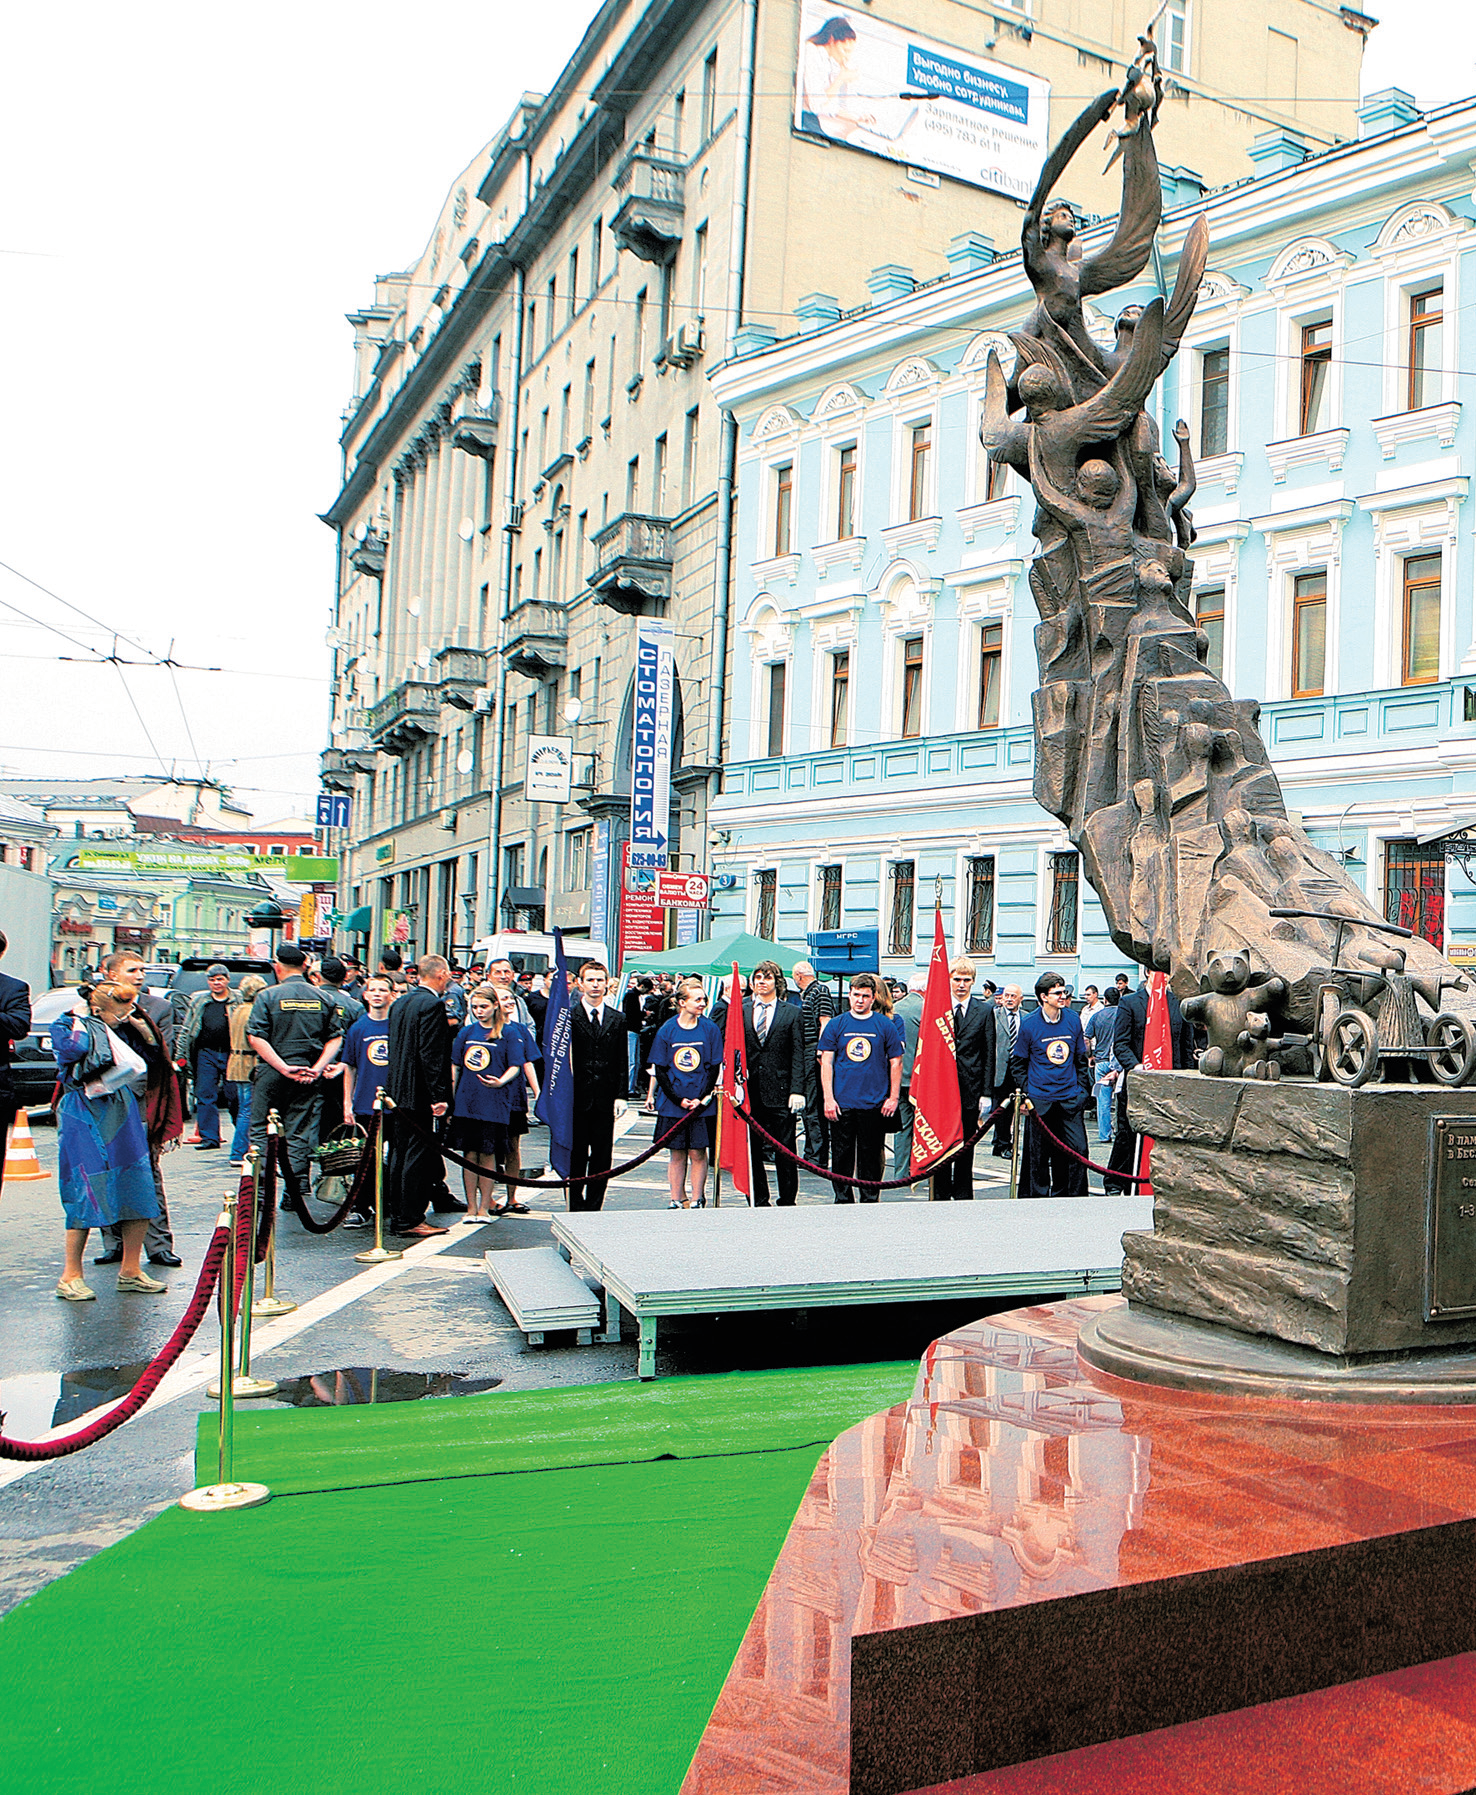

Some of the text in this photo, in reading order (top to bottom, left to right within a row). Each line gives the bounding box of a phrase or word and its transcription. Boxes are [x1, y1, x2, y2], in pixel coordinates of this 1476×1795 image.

[912, 51, 961, 80] Выгодно
[912, 67, 953, 93] Удобно
[657, 651, 672, 759] ЛАЗЕРНАЯ
[635, 648, 657, 838] СТОМАТОЛОГИЯ
[689, 881, 704, 890] 24
[660, 898, 707, 909] БАНКОМАТ
[1447, 1134, 1455, 1146] В
[1459, 1203, 1475, 1217] 1-3
